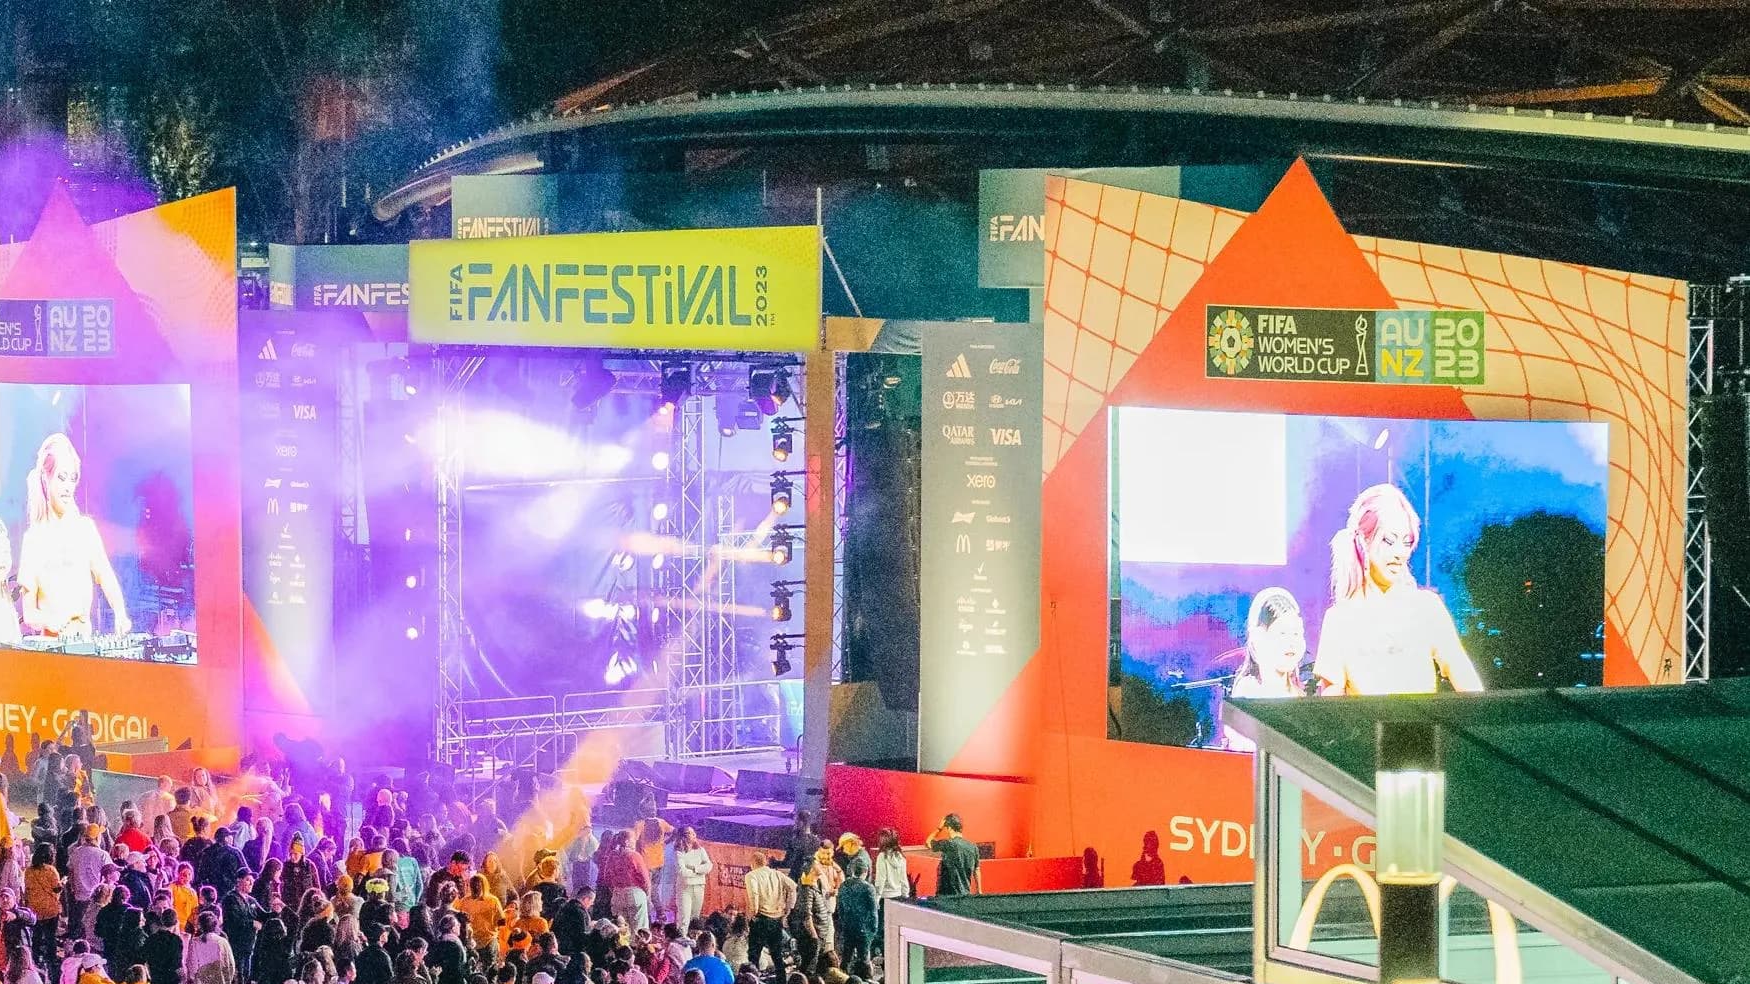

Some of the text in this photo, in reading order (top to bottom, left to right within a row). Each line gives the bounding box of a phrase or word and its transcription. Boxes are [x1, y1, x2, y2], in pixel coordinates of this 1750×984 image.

[990, 215, 999, 242] FIFA
[449, 263, 463, 321] FIFA
[755, 265, 768, 327] 2023
[49, 305, 112, 329] AU 20
[1257, 313, 1298, 335] FIFA
[49, 329, 112, 352] NZ 23
[1380, 317, 1480, 348] AU 20
[10, 337, 33, 352] CUP
[1257, 336, 1334, 356] WOMEN'S
[1257, 355, 1350, 376] WORLD CUP
[1380, 348, 1480, 379] NZ 23
[293, 404, 317, 420] VISA
[942, 424, 975, 439] QATAR
[989, 428, 1022, 446] VISA
[966, 474, 996, 489] xero
